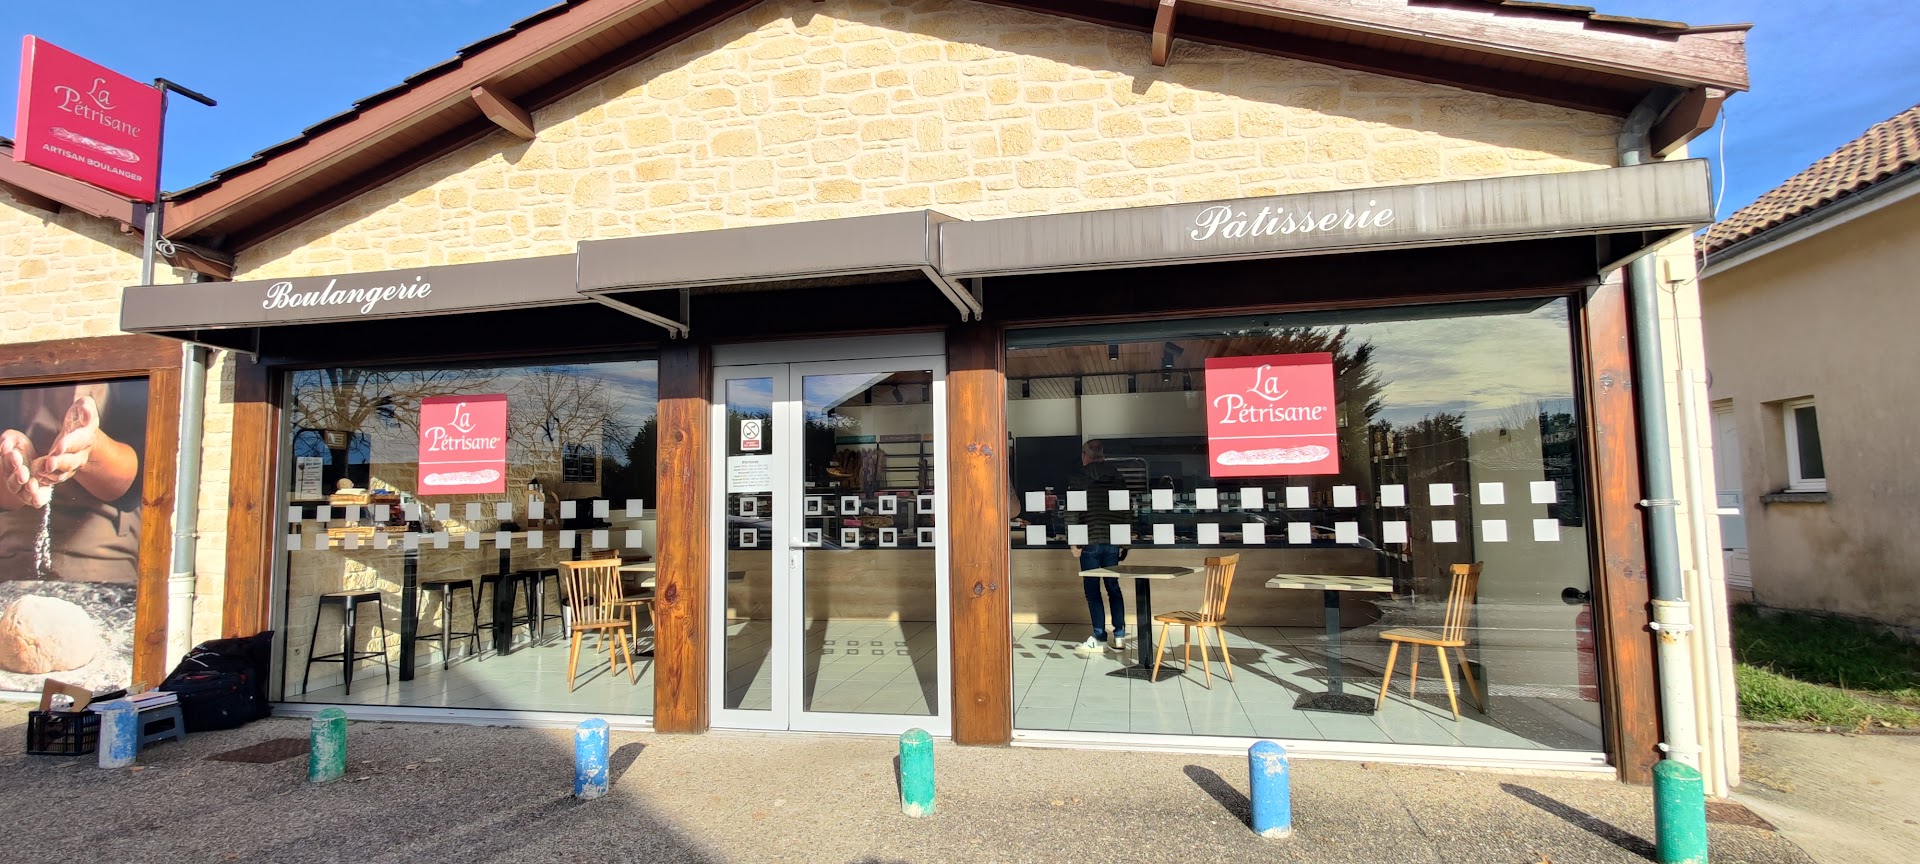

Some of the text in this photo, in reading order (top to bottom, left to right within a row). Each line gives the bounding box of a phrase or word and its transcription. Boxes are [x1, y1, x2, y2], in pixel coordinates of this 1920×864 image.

[54, 85, 141, 138] Pétrisane
[86, 77, 117, 110] La
[42, 143, 143, 182] ARTISAN BOULANGER
[1190, 199, 1396, 241] Pâtisserie
[262, 275, 432, 314] Boulangerie
[1245, 363, 1289, 402] La
[447, 402, 477, 433] La
